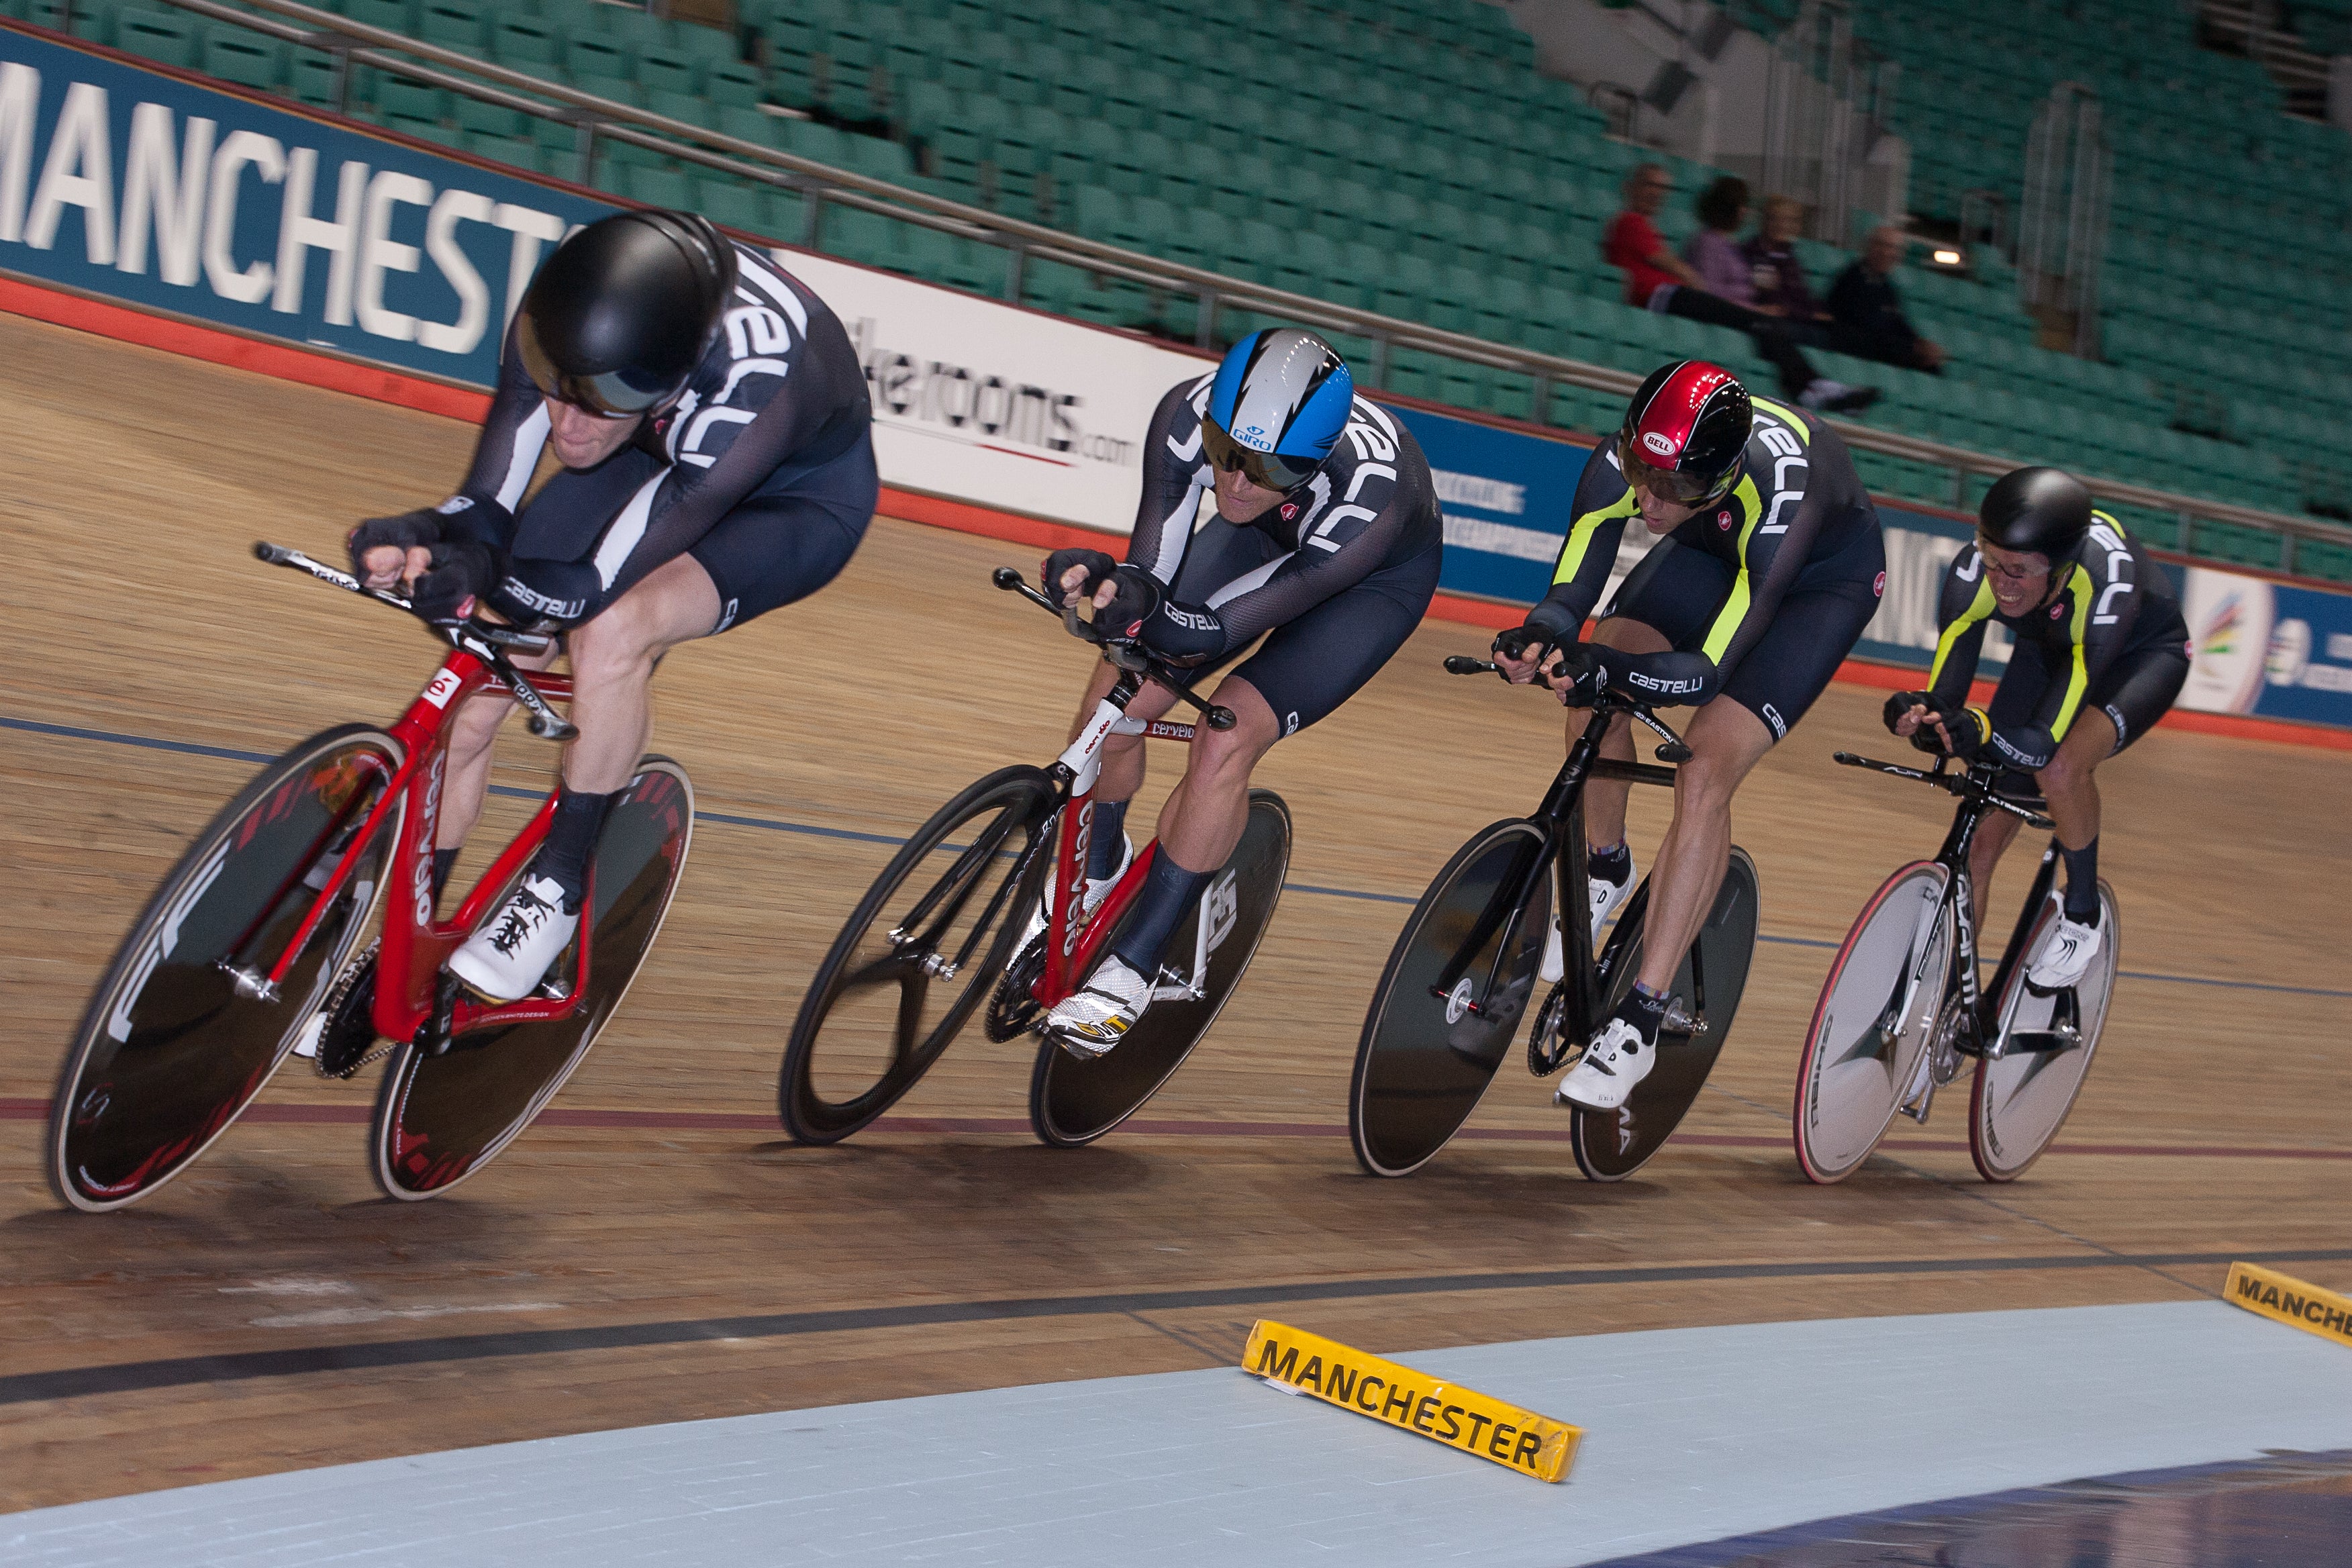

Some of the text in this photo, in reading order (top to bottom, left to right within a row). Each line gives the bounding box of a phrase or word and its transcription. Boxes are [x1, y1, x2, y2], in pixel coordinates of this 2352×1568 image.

[1234, 428, 1271, 450] GIRO
[1647, 436, 1669, 452] BELL
[1645, 716, 1673, 744] EASTON
[1257, 1339, 1542, 1469] MANCHESTER
